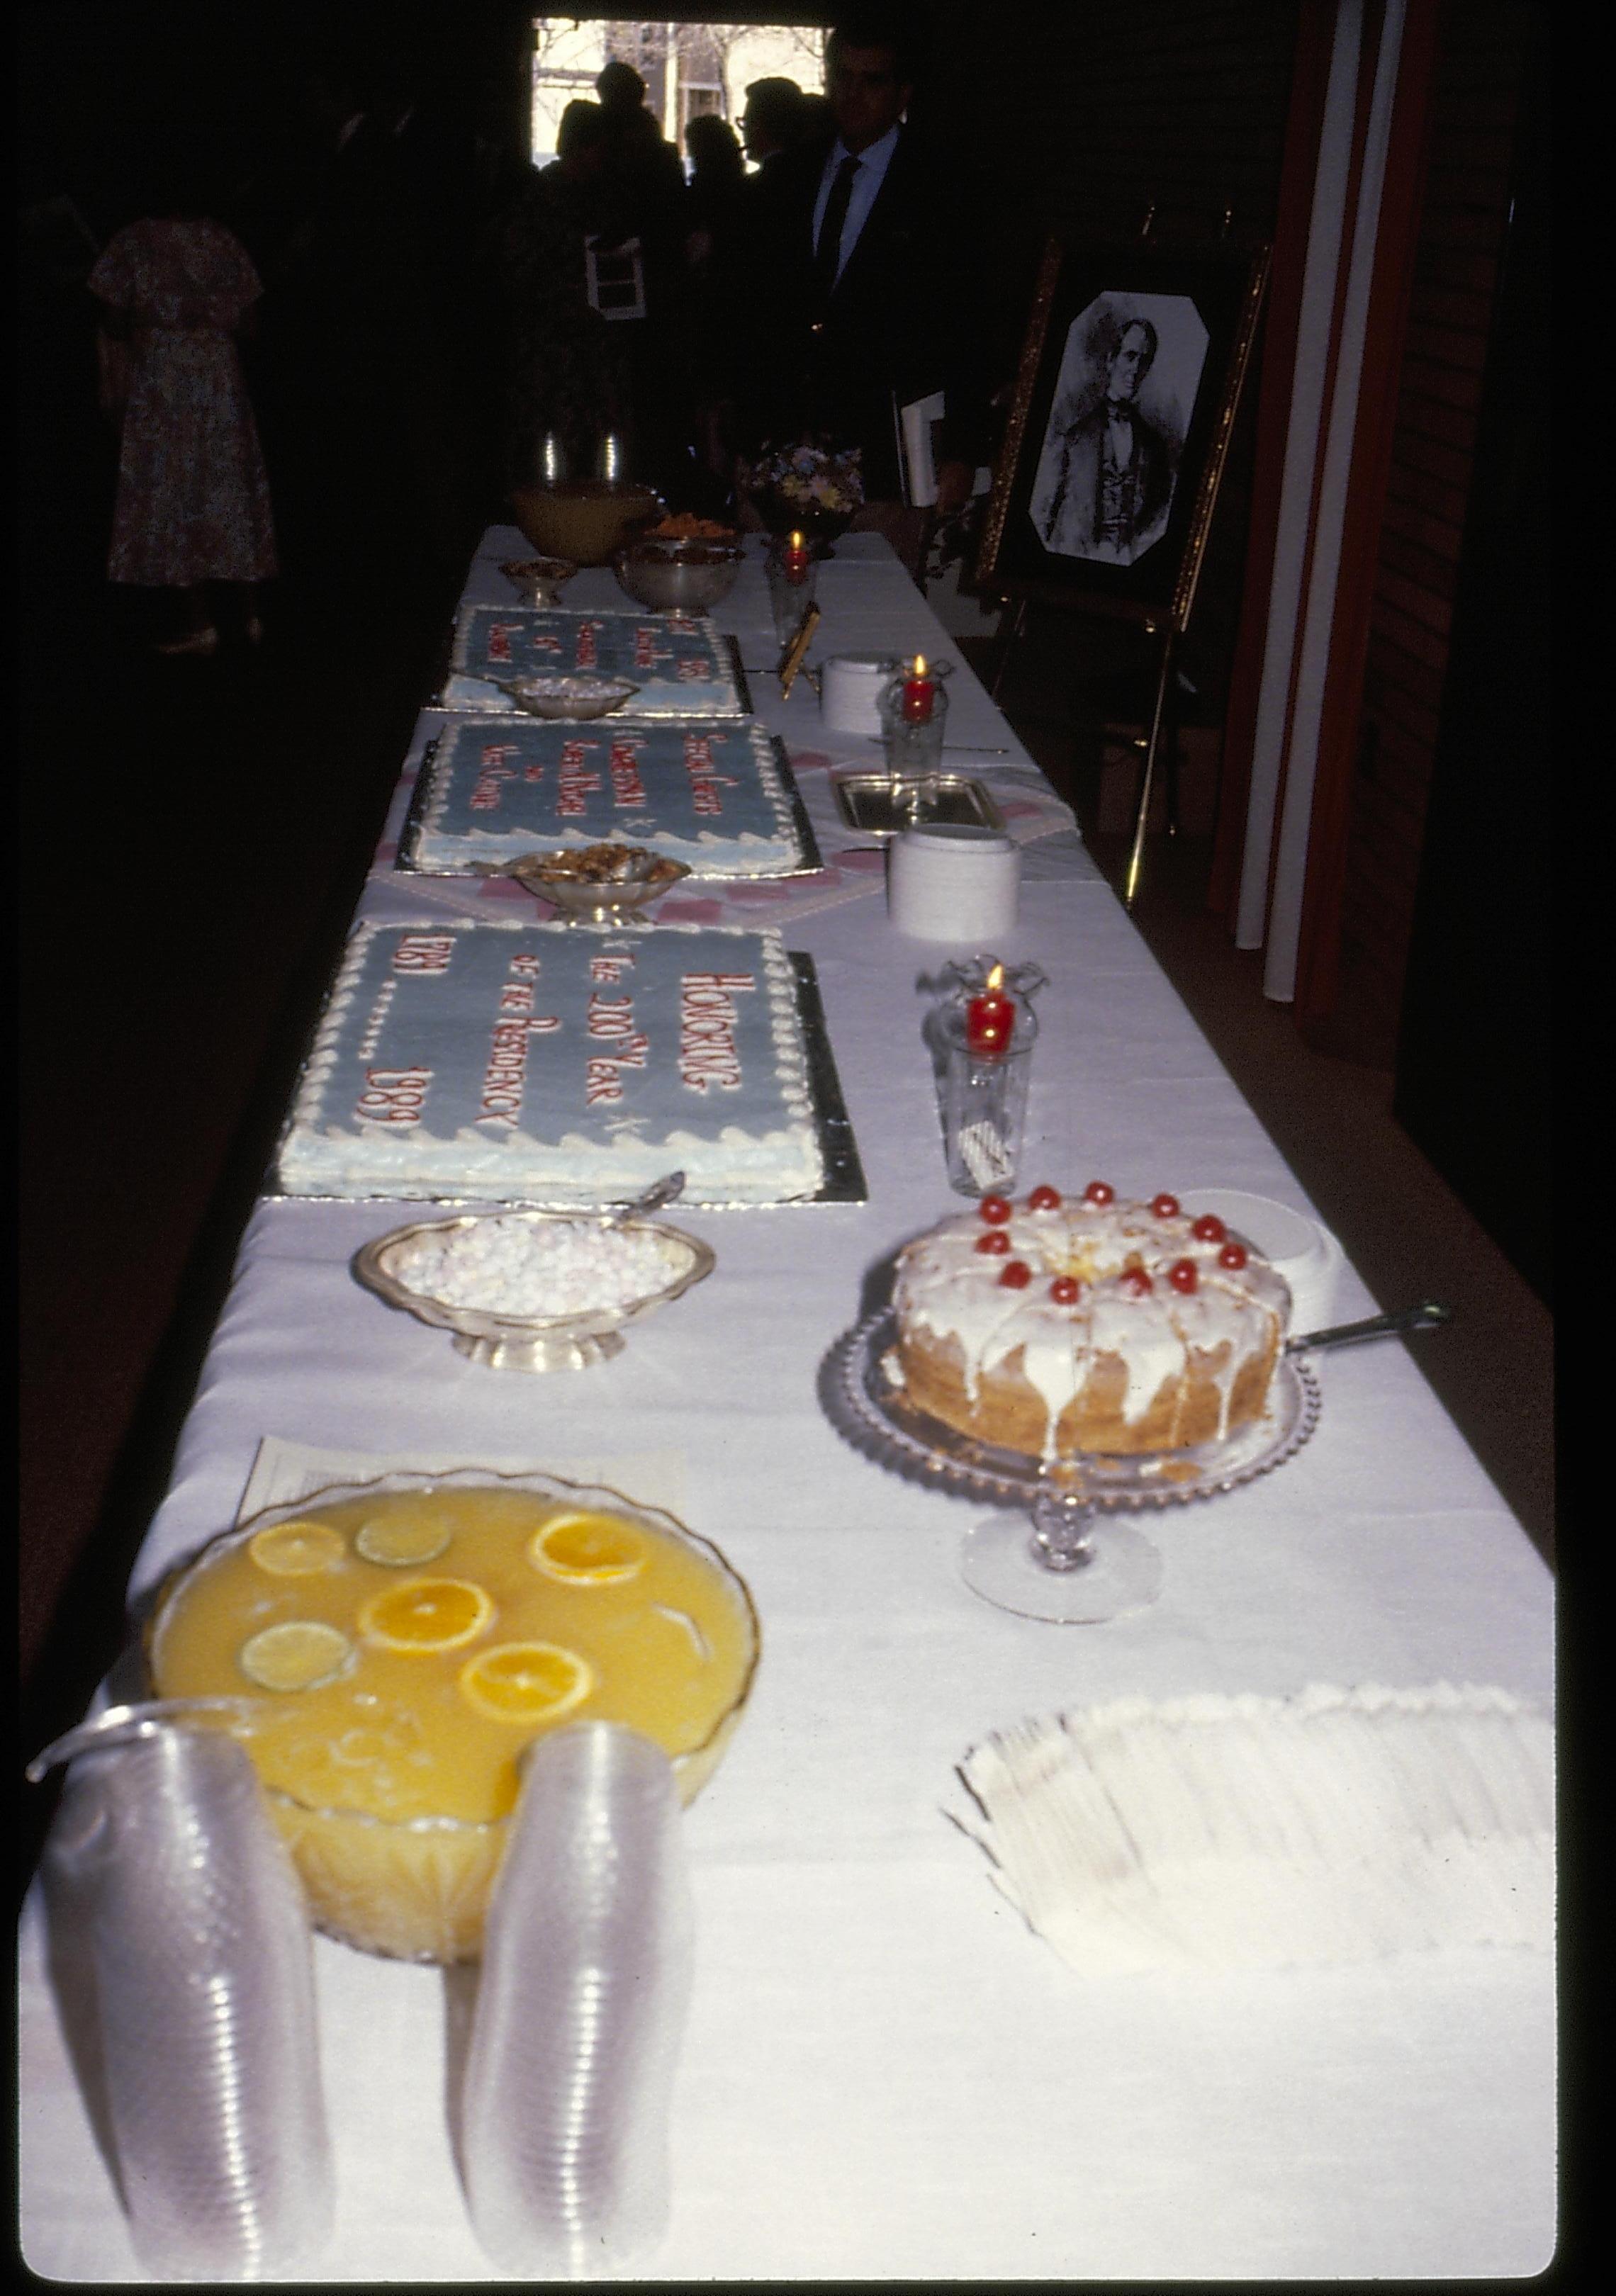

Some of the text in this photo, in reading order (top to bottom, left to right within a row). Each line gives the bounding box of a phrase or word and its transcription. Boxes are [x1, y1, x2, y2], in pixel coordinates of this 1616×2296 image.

[510, 953, 541, 978] OF
[590, 953, 636, 984] THE
[500, 982, 537, 1012] THE
[678, 973, 757, 1095] HONORING
[353, 1066, 435, 1130] 1989
[585, 1053, 648, 1108] YEAR
